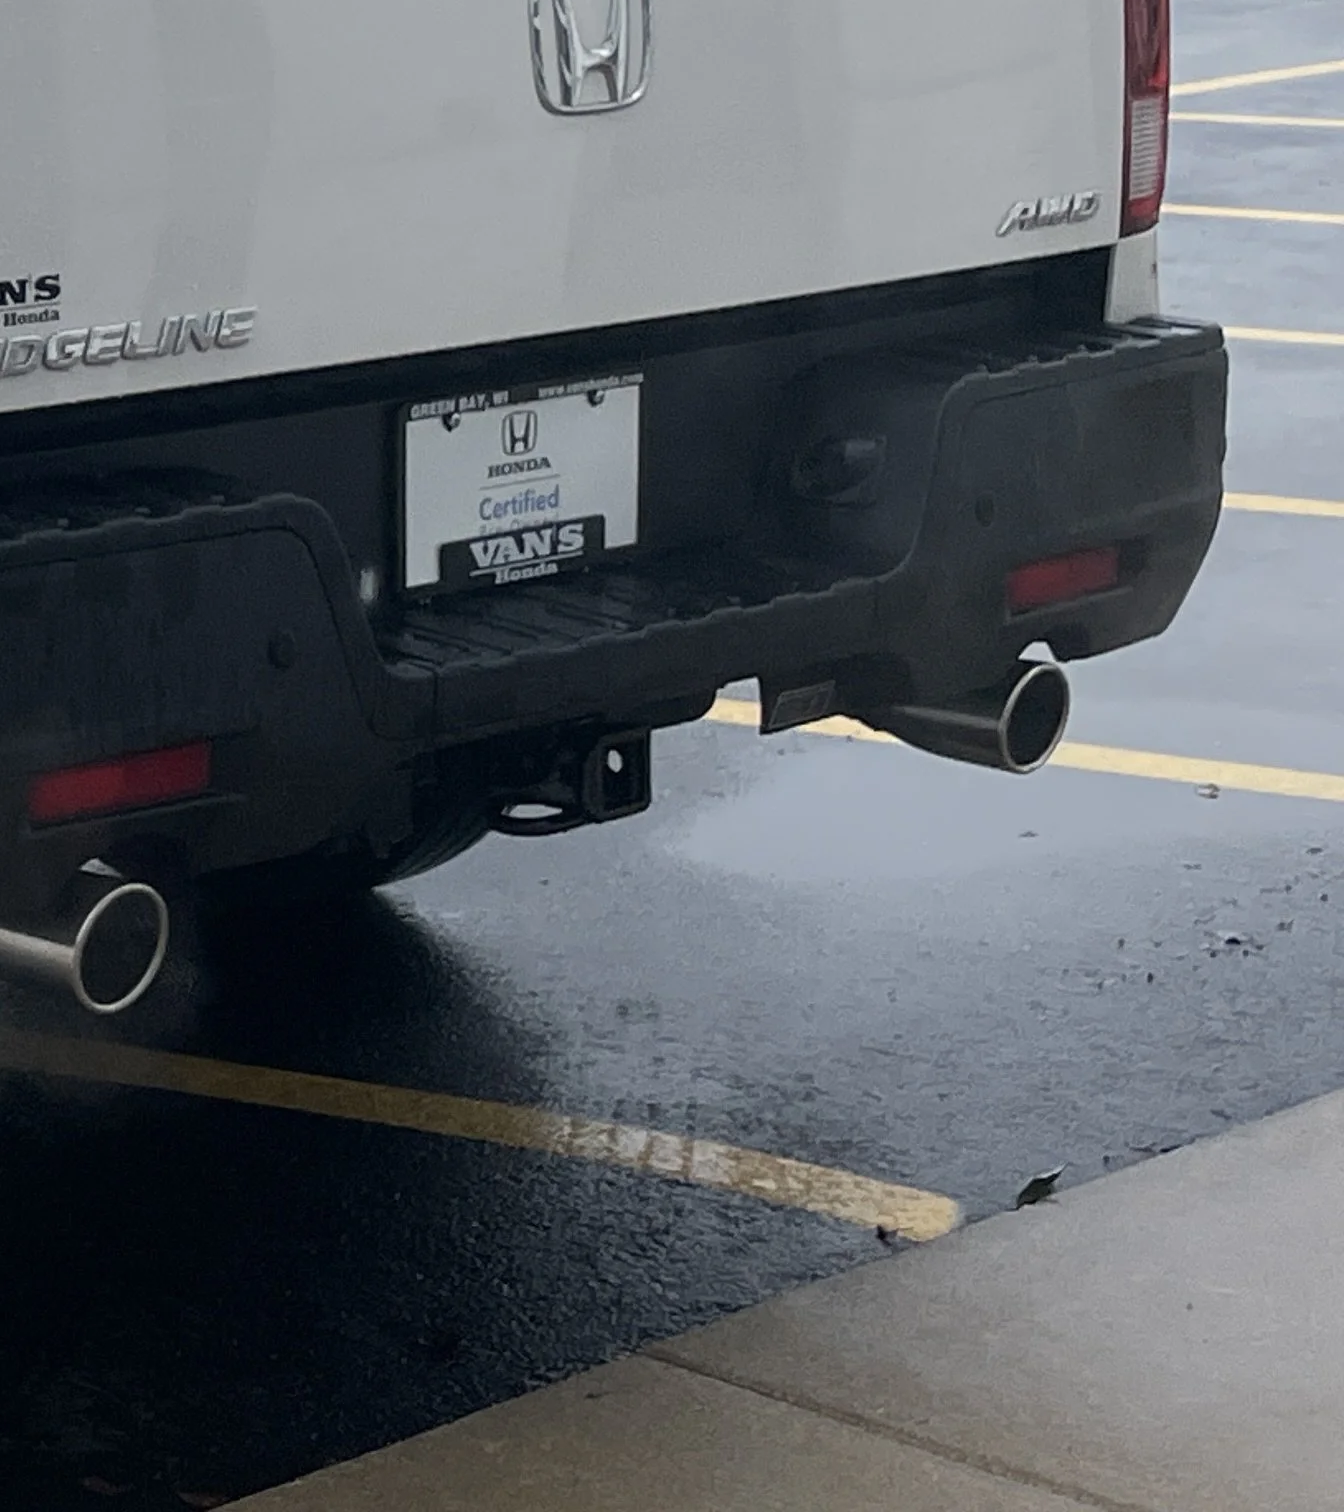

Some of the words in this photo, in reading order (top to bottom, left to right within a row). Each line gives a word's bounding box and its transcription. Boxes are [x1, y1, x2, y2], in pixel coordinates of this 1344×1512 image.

[995, 189, 1100, 238] AWD
[3, 308, 60, 327] Honda
[410, 399, 456, 419] GREEN
[487, 456, 551, 479] HONDA
[479, 484, 560, 521] Certified
[469, 522, 584, 569] VAN'S
[495, 562, 559, 585] Honda
